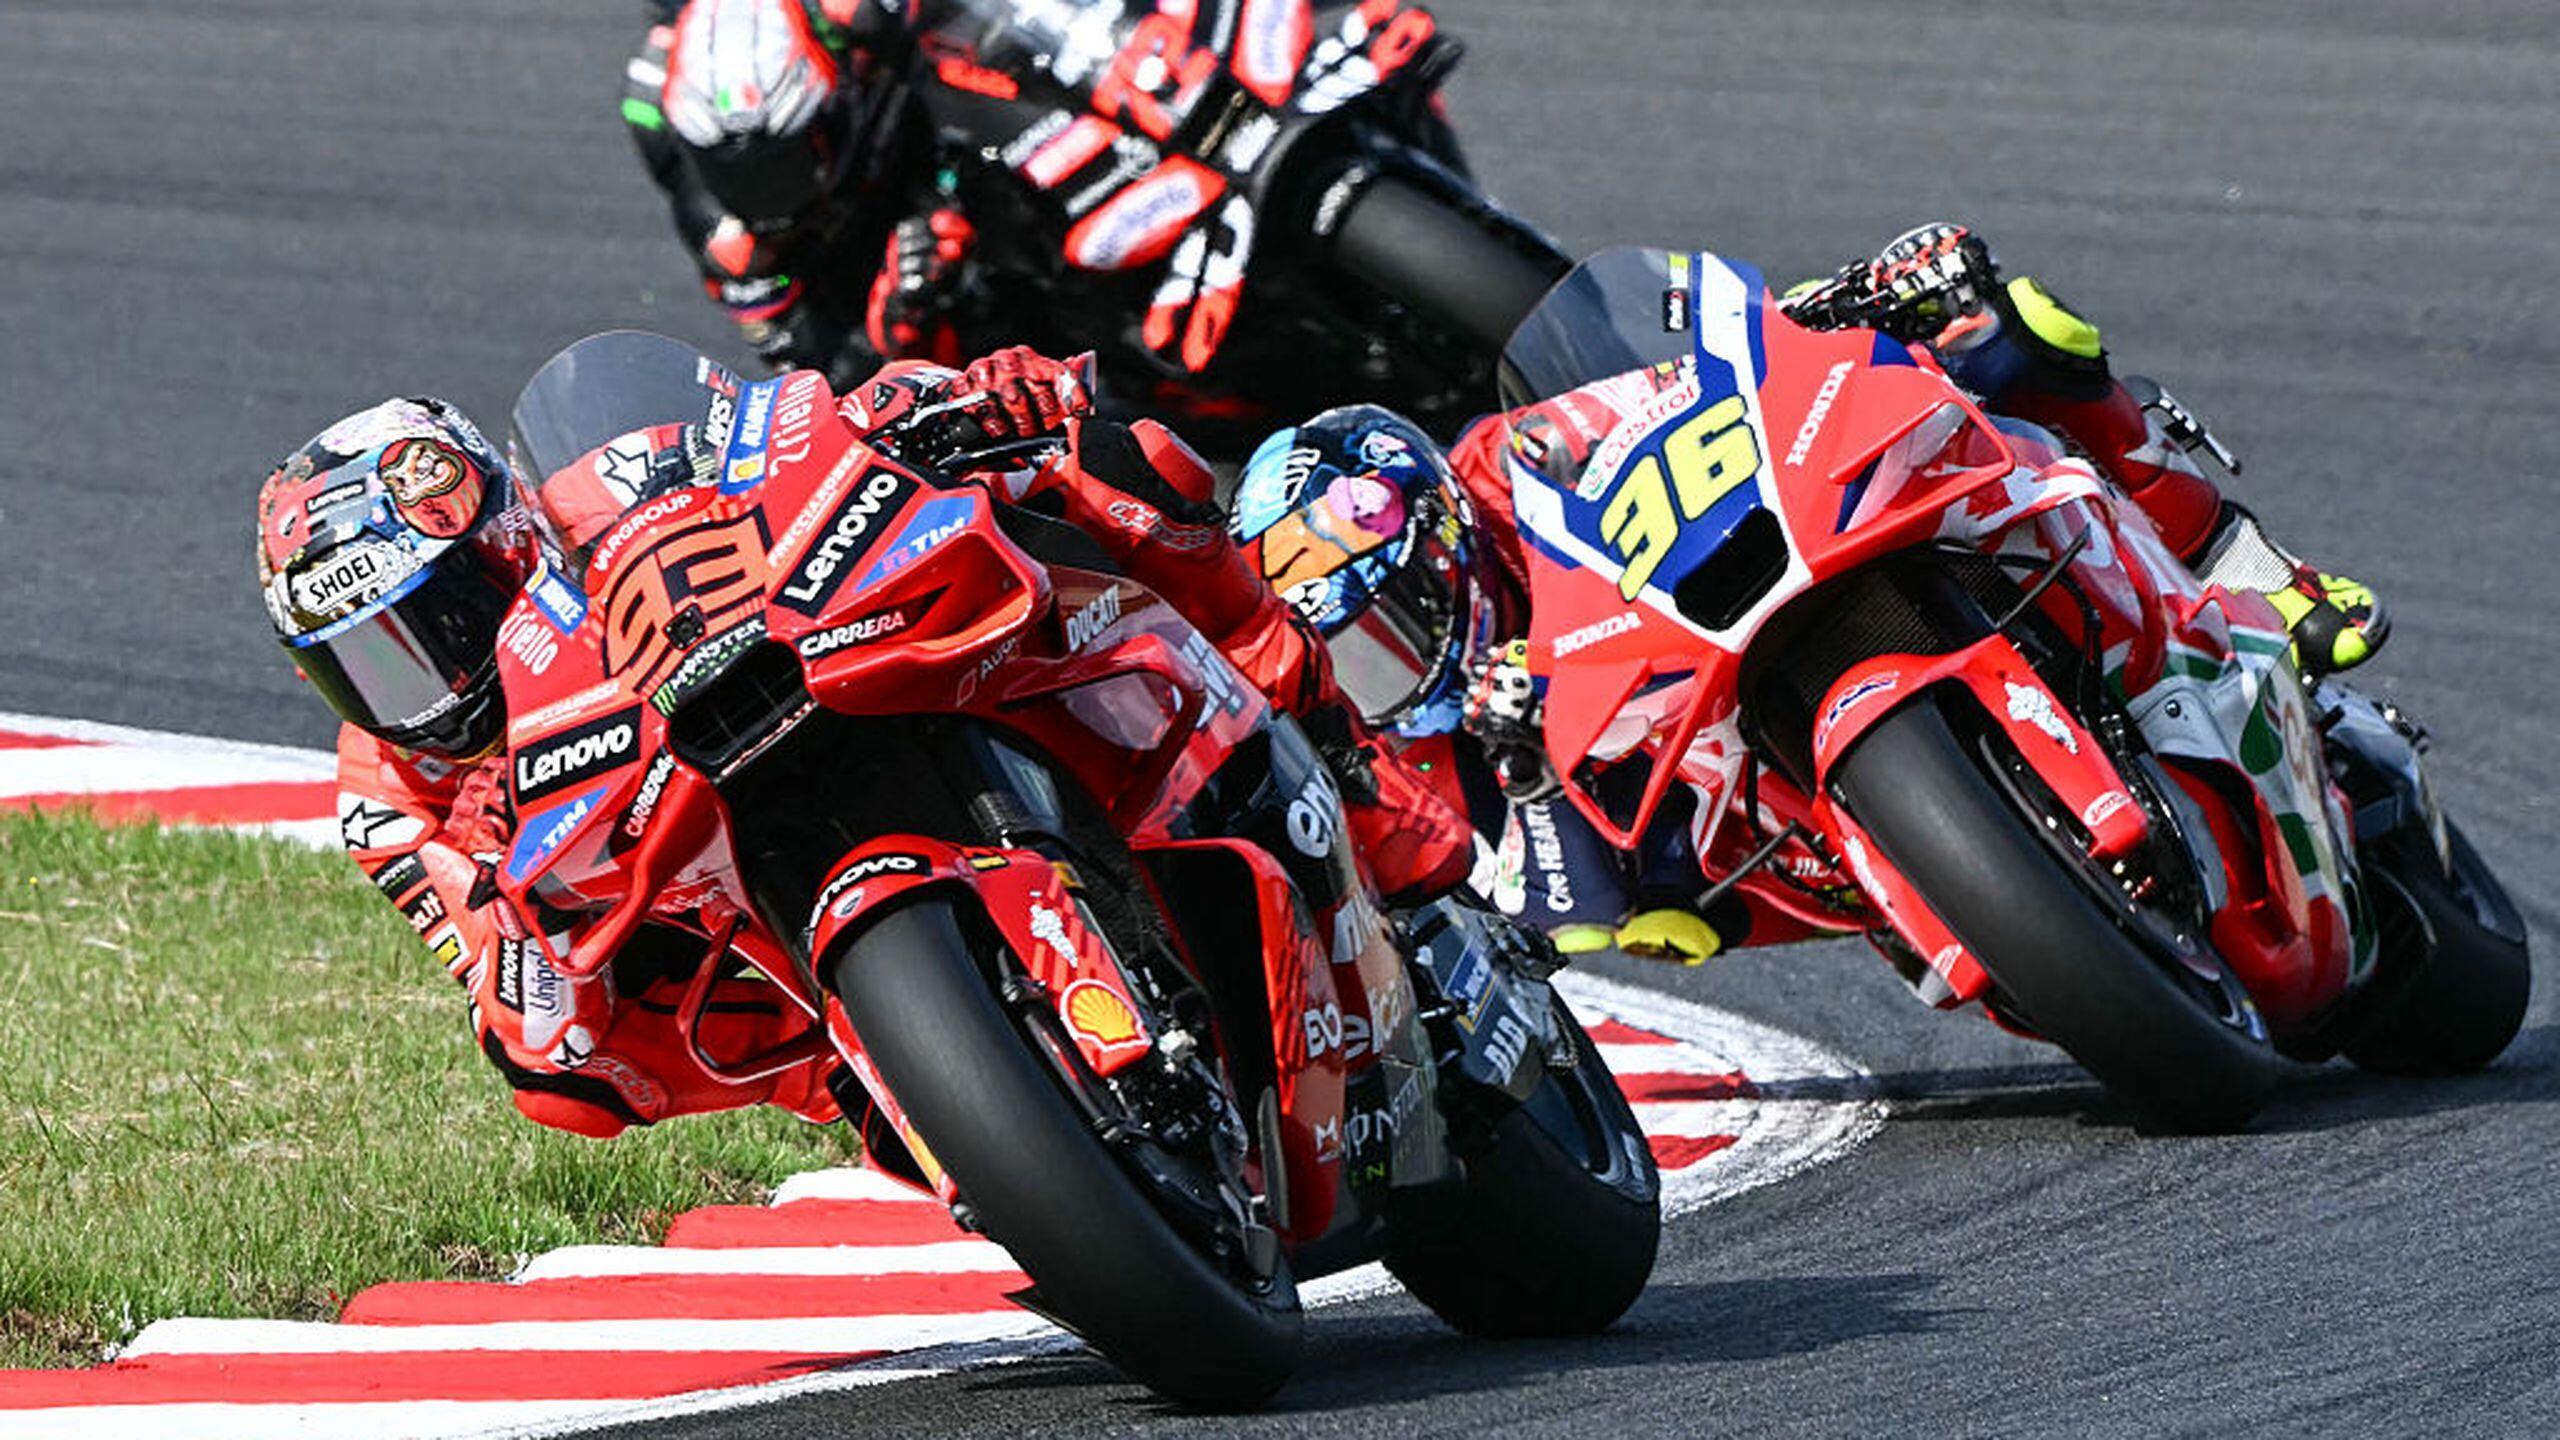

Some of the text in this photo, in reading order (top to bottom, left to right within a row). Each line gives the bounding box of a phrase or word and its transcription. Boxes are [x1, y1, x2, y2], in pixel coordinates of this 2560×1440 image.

[1785, 360, 1855, 466] HONDA
[1600, 394, 1763, 602] 36
[784, 473, 899, 602] Lenovo
[909, 516, 966, 552] TIM
[309, 552, 377, 605] SHOEI
[799, 611, 906, 656] CARRERA
[1066, 583, 1121, 653] DUCATI
[1553, 611, 1643, 659] HONDA
[518, 723, 633, 792] Lenovo
[540, 798, 588, 849] TIM
[625, 756, 672, 838] CARRERA
